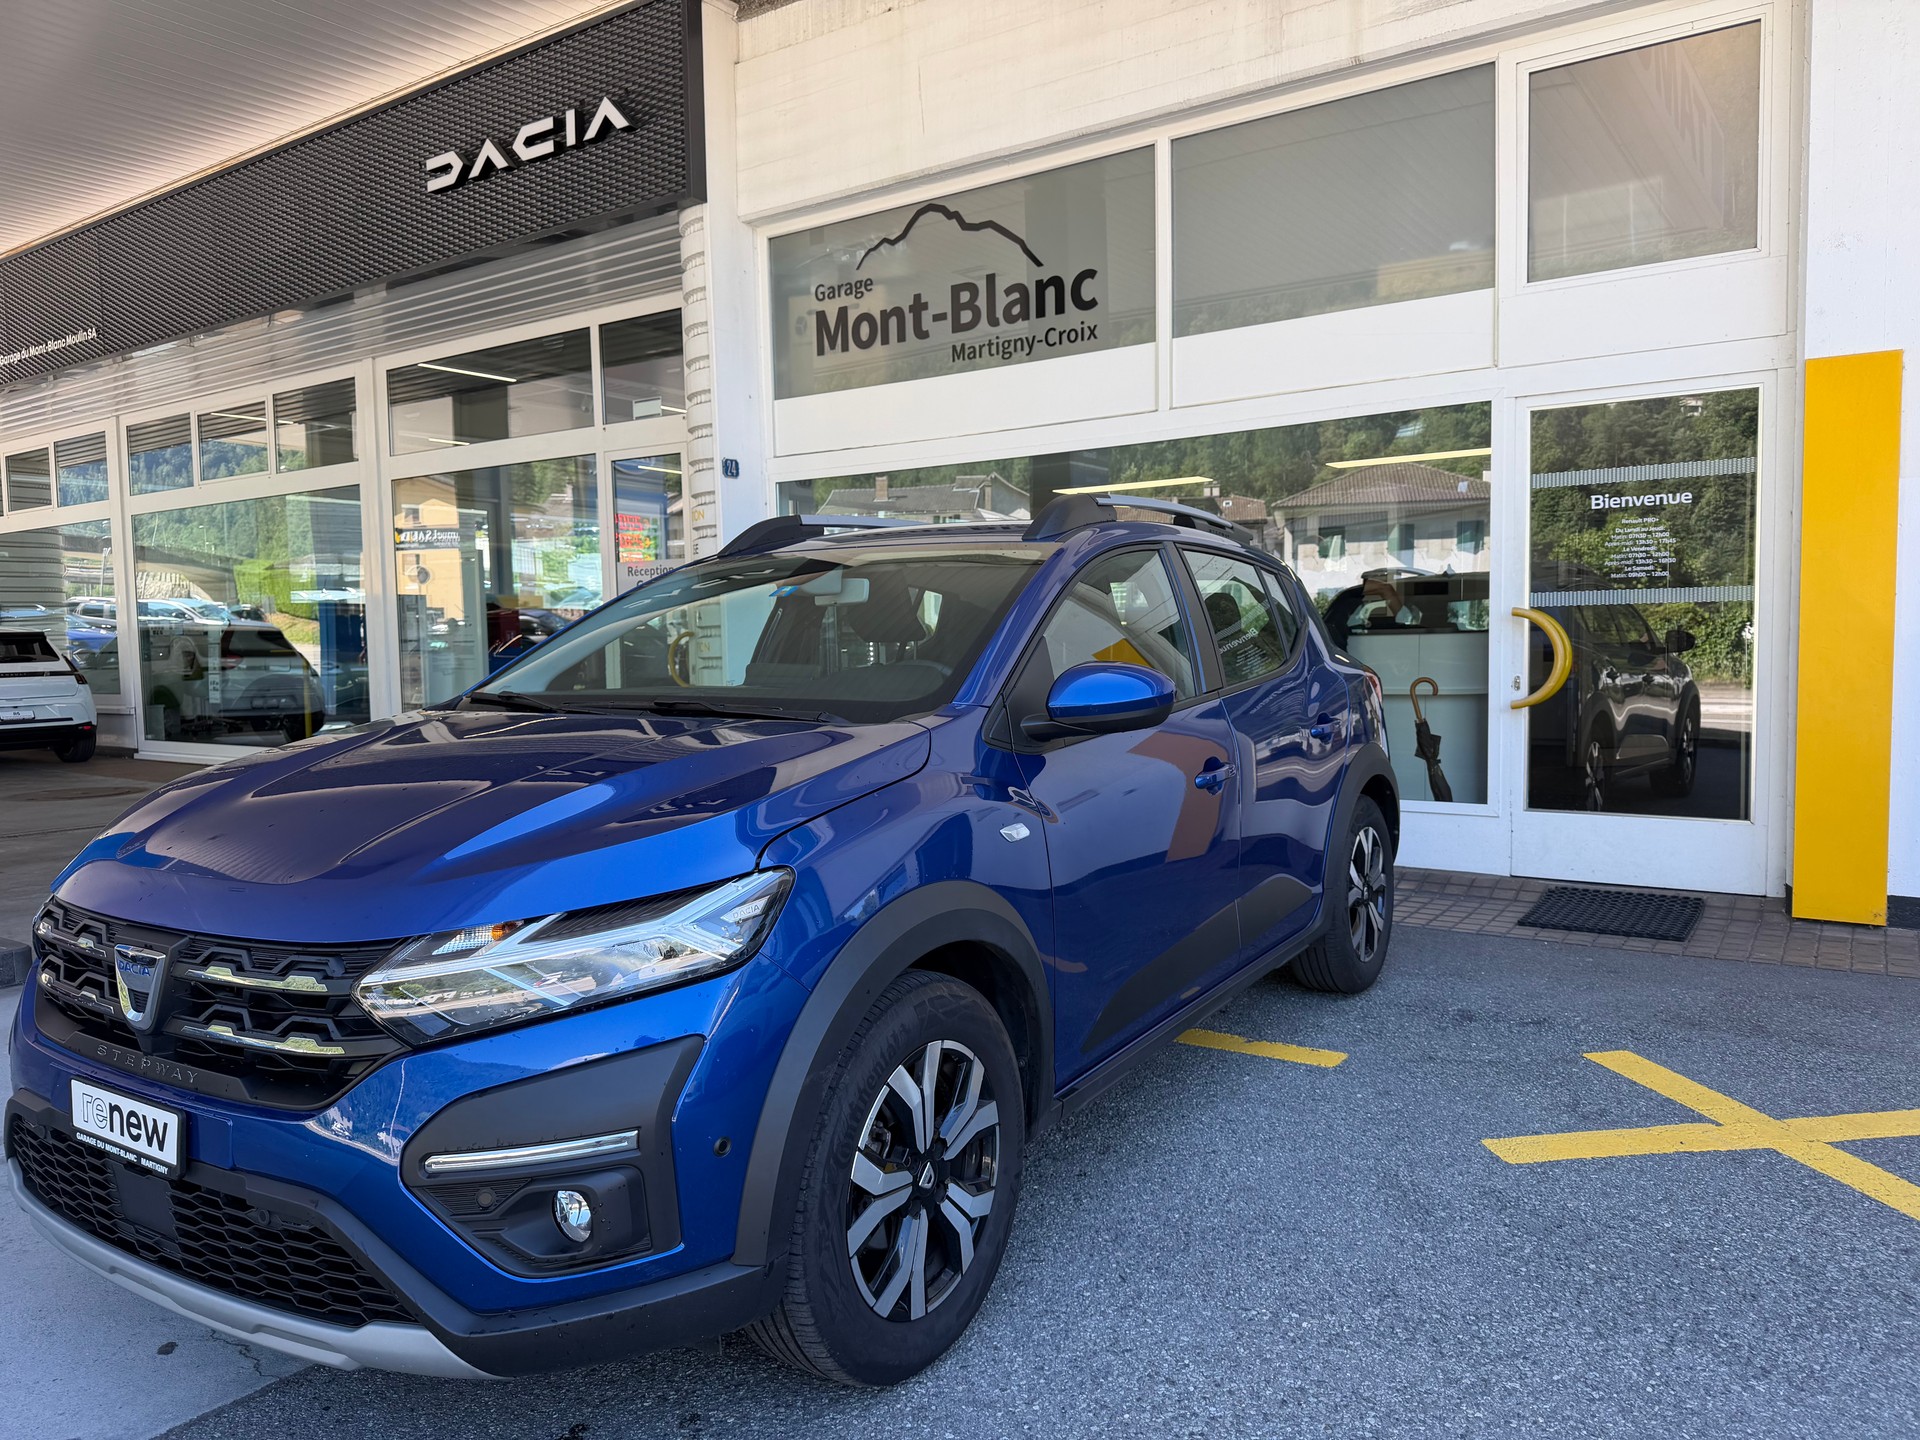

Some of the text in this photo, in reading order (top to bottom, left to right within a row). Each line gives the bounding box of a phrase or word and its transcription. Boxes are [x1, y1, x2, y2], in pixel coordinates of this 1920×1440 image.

[426, 96, 633, 193] DACIA
[814, 277, 874, 302] Garage
[815, 268, 1099, 357] Mont-Blanc
[951, 320, 1098, 363] Martigny-Croix
[726, 460, 737, 476] 24
[1590, 491, 1693, 510] Bienvenue
[117, 959, 151, 977] DACIA
[97, 1044, 199, 1084] STEPWAY
[81, 1091, 169, 1153] renew
[76, 1131, 169, 1175] GARAGE DU MONT-BLANC MARTIGNY
